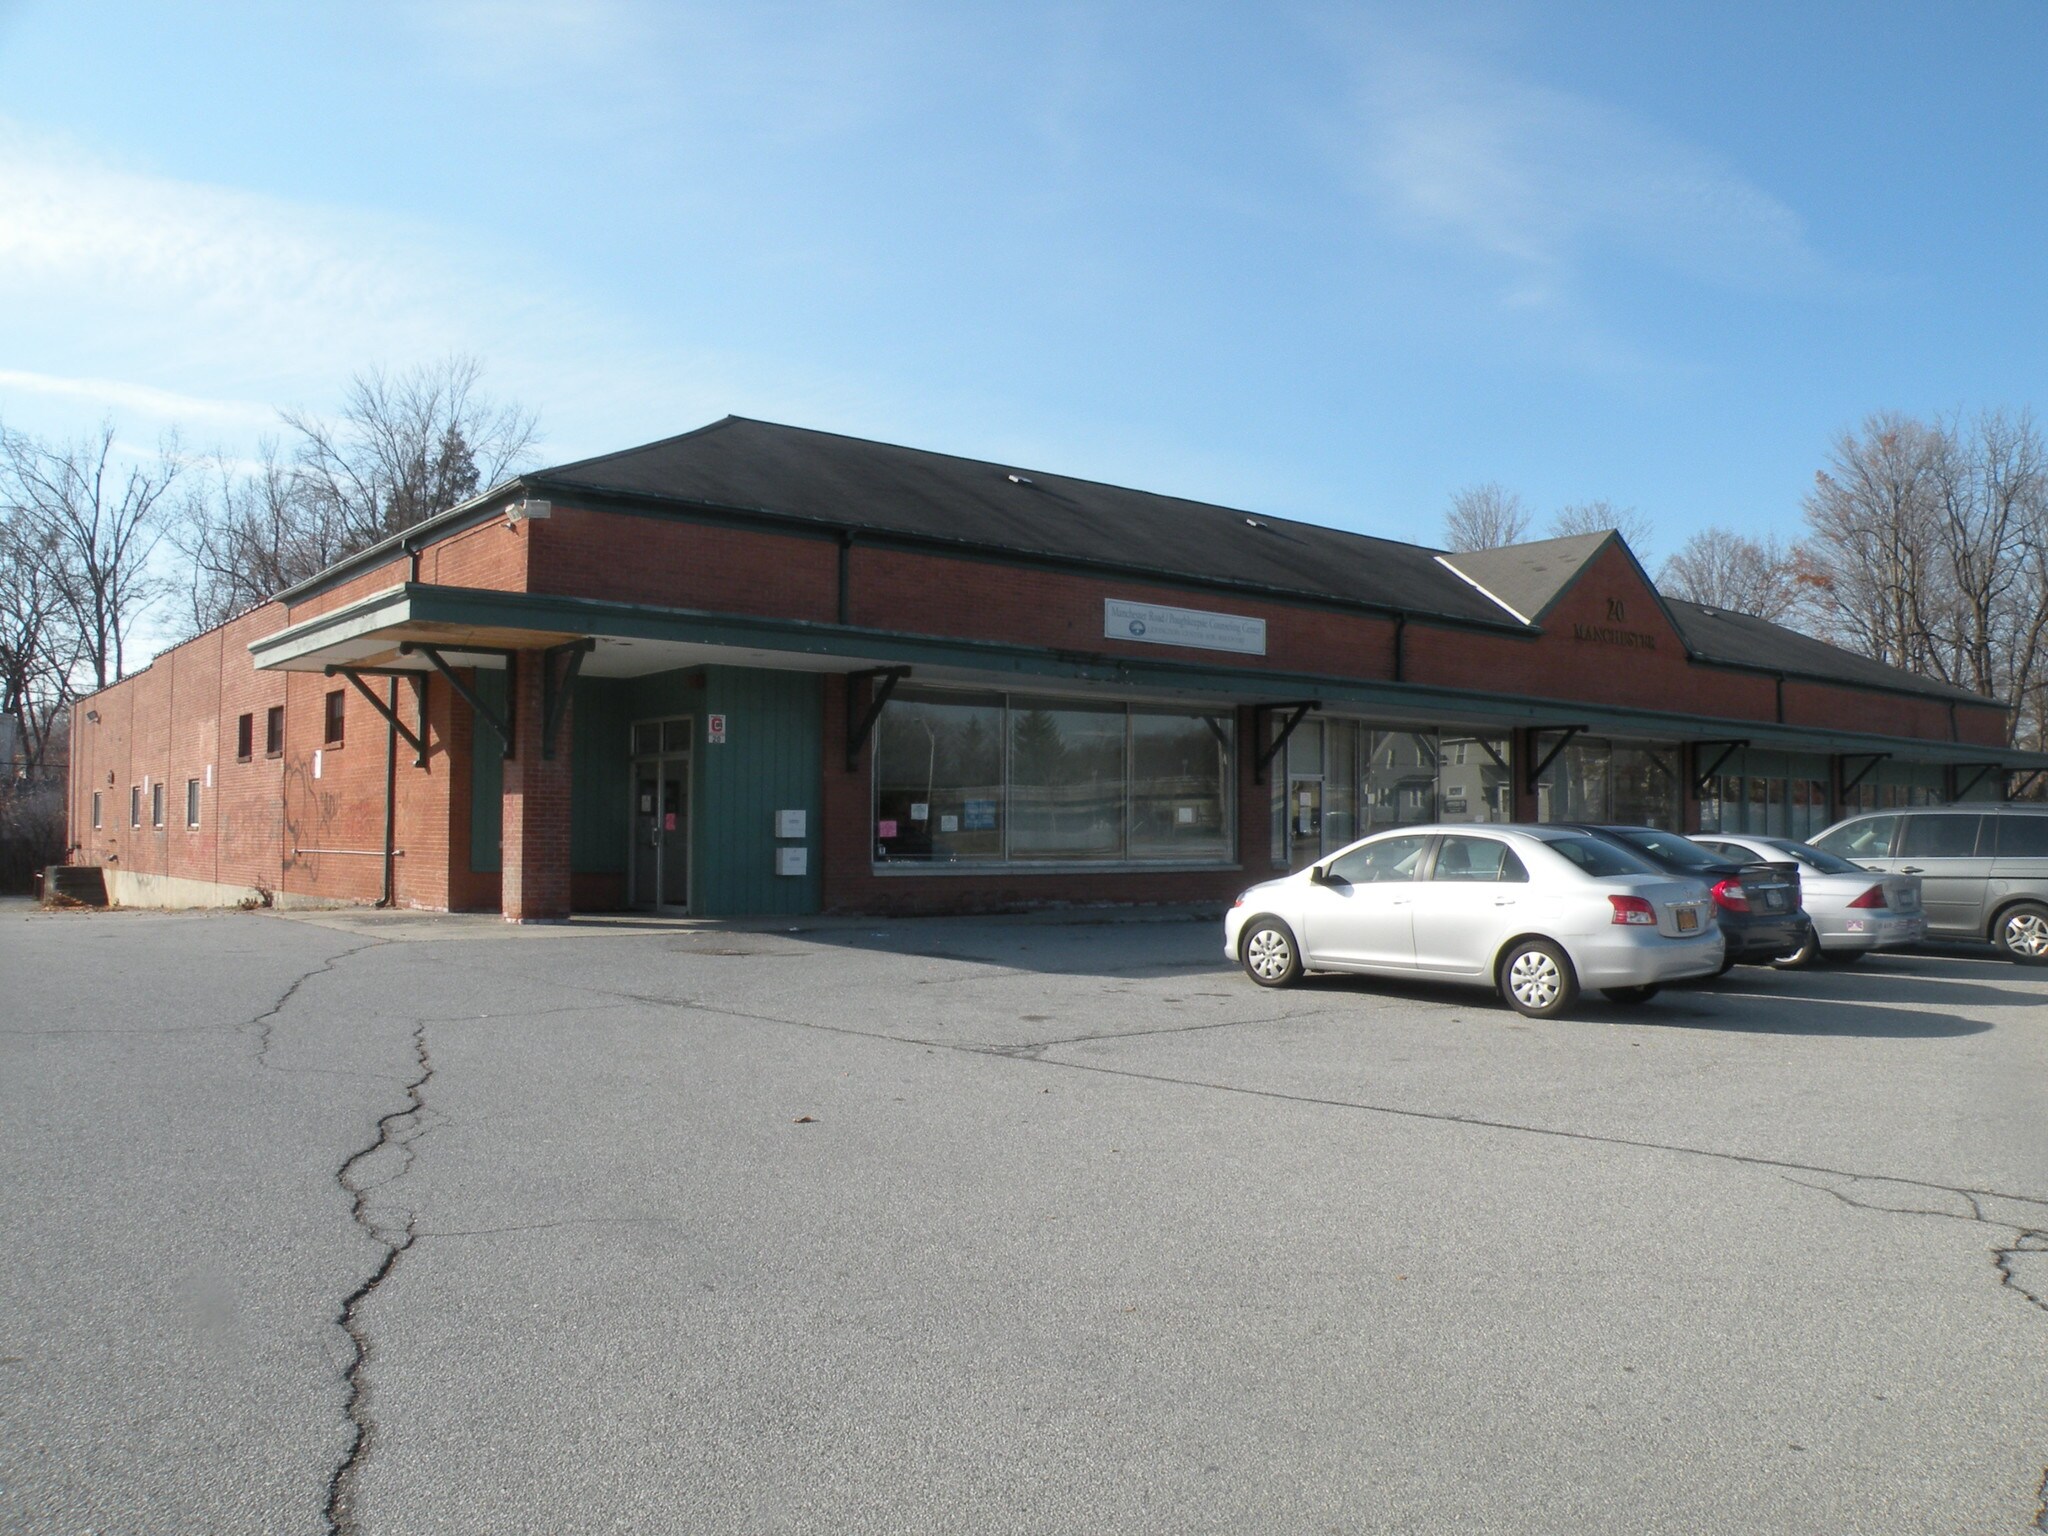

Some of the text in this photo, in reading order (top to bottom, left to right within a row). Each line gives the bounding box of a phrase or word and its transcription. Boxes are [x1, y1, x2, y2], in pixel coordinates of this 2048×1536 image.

[1111, 606, 1147, 621] Manchester
[1148, 610, 1165, 623] Road
[1607, 597, 1625, 623] 20
[1573, 623, 1656, 650] MANCHESTER
